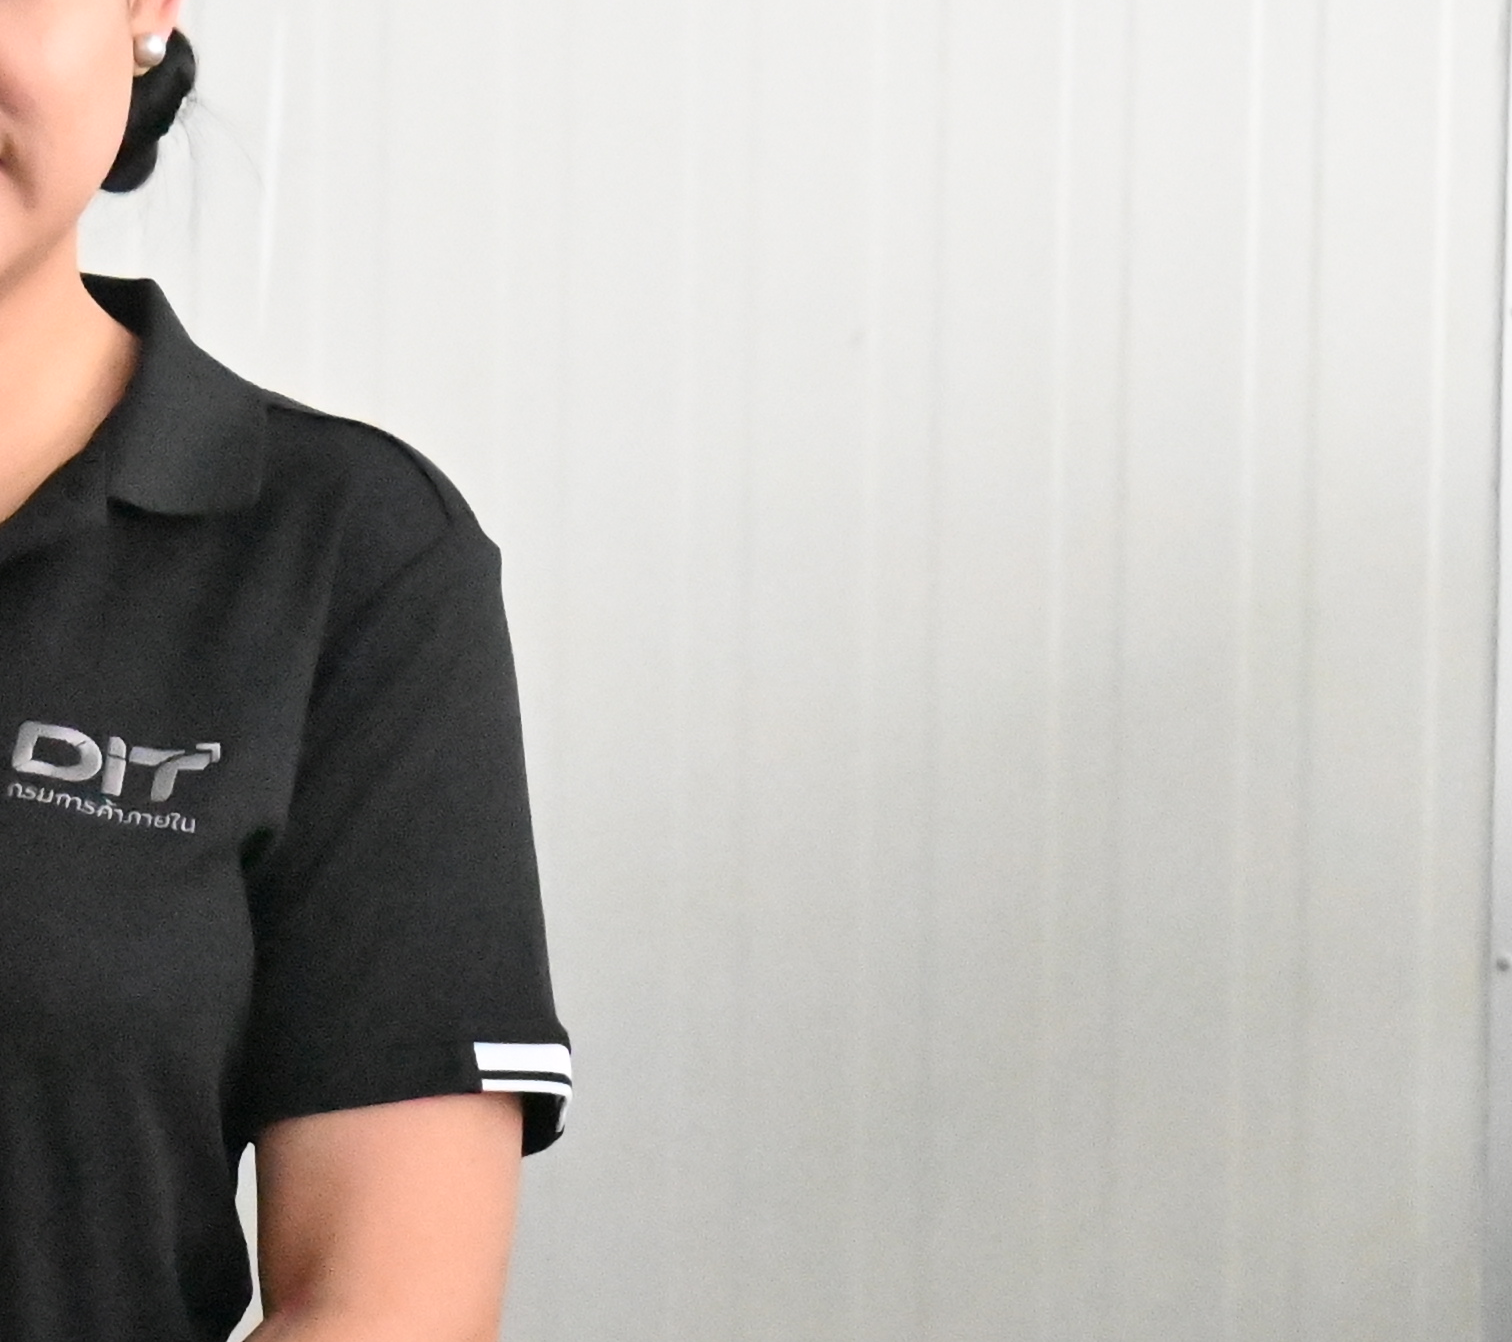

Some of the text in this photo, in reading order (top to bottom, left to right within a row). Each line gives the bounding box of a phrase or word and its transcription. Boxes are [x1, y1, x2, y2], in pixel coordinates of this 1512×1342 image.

[12, 720, 221, 802] DIT
[6, 781, 197, 834] กรมการค้าภายใน
